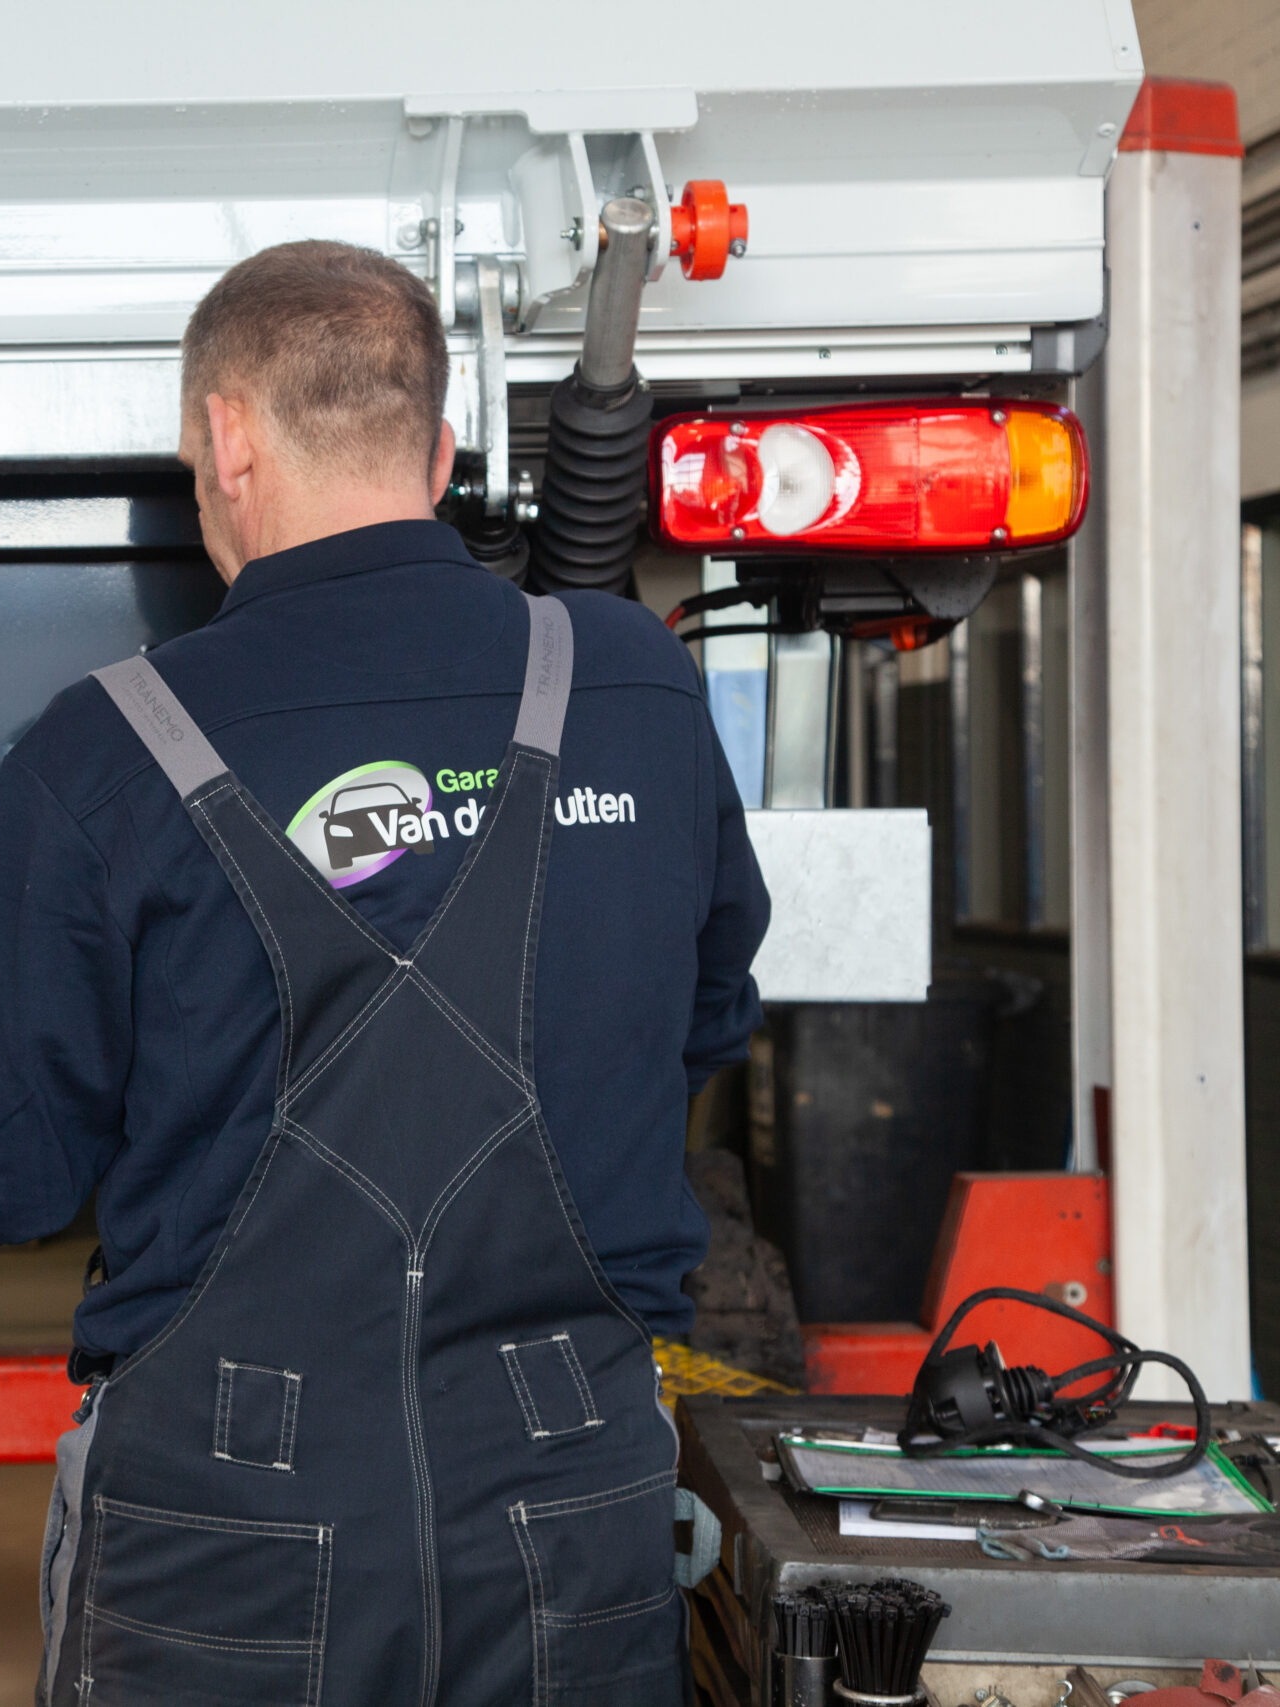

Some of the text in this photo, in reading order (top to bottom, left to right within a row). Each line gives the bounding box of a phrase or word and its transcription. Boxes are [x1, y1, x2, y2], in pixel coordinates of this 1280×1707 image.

[536, 616, 555, 697] TRANEMO
[128, 671, 185, 742] TRANEMO
[436, 768, 499, 794] Gara
[367, 786, 637, 848] Van d utten
